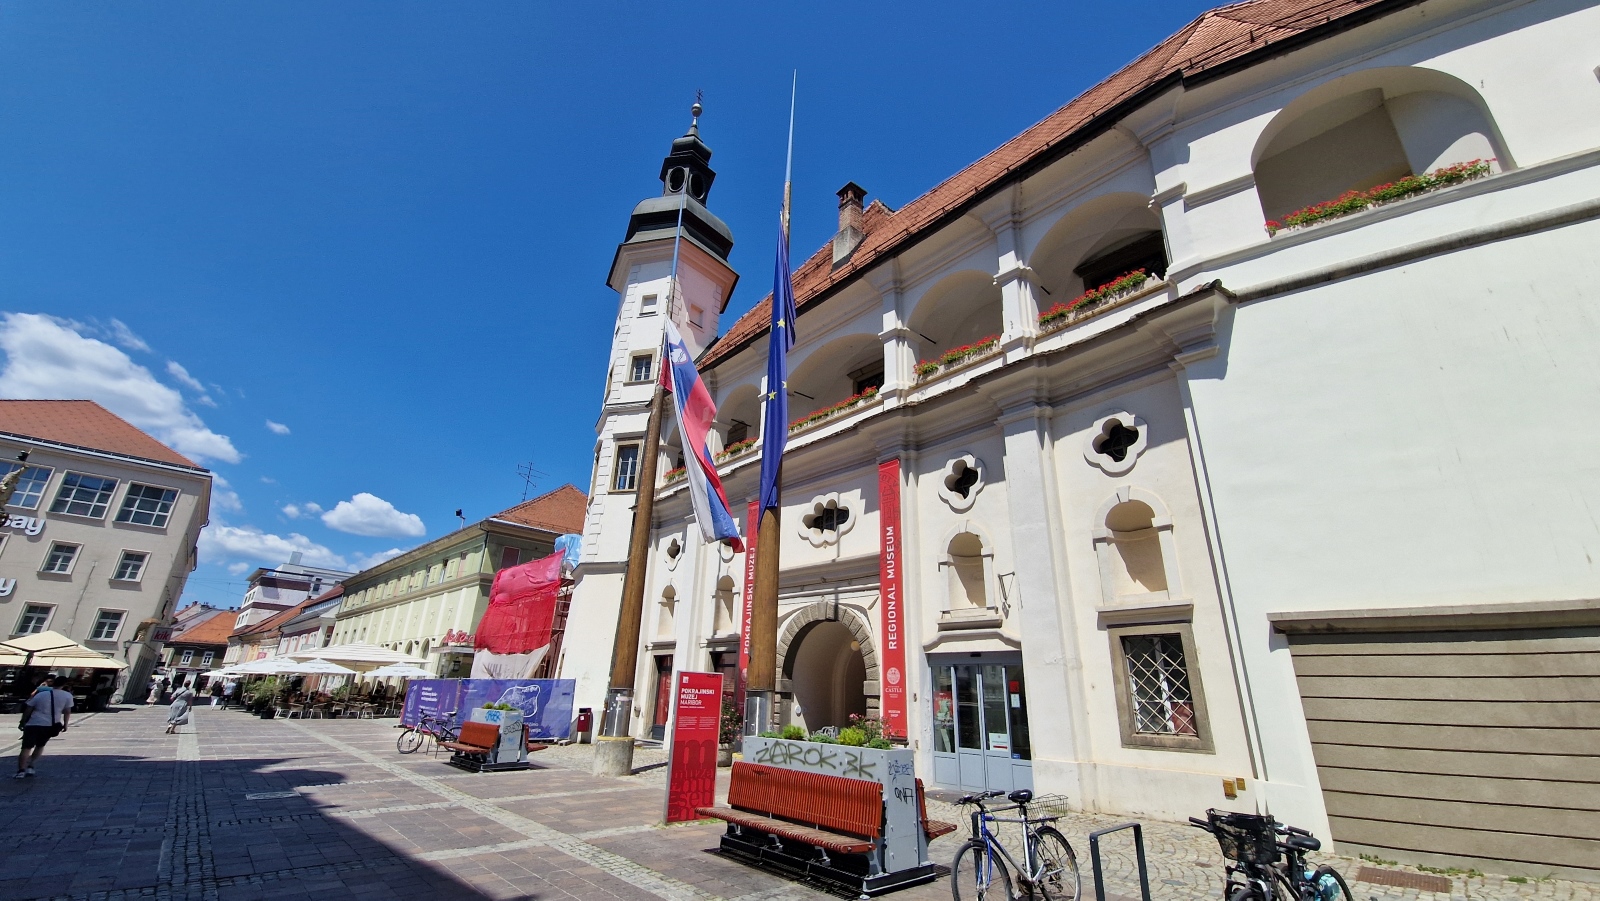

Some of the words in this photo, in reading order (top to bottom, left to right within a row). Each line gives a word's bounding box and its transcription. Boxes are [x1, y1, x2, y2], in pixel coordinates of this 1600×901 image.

[748, 547, 756, 580] MUZEJ
[886, 526, 895, 579] MUSEUM
[154, 630, 169, 641] kik
[744, 583, 754, 655] POKRAJINSKI
[887, 583, 897, 650] REGIONAL
[681, 687, 715, 695] POKRAJINSKI
